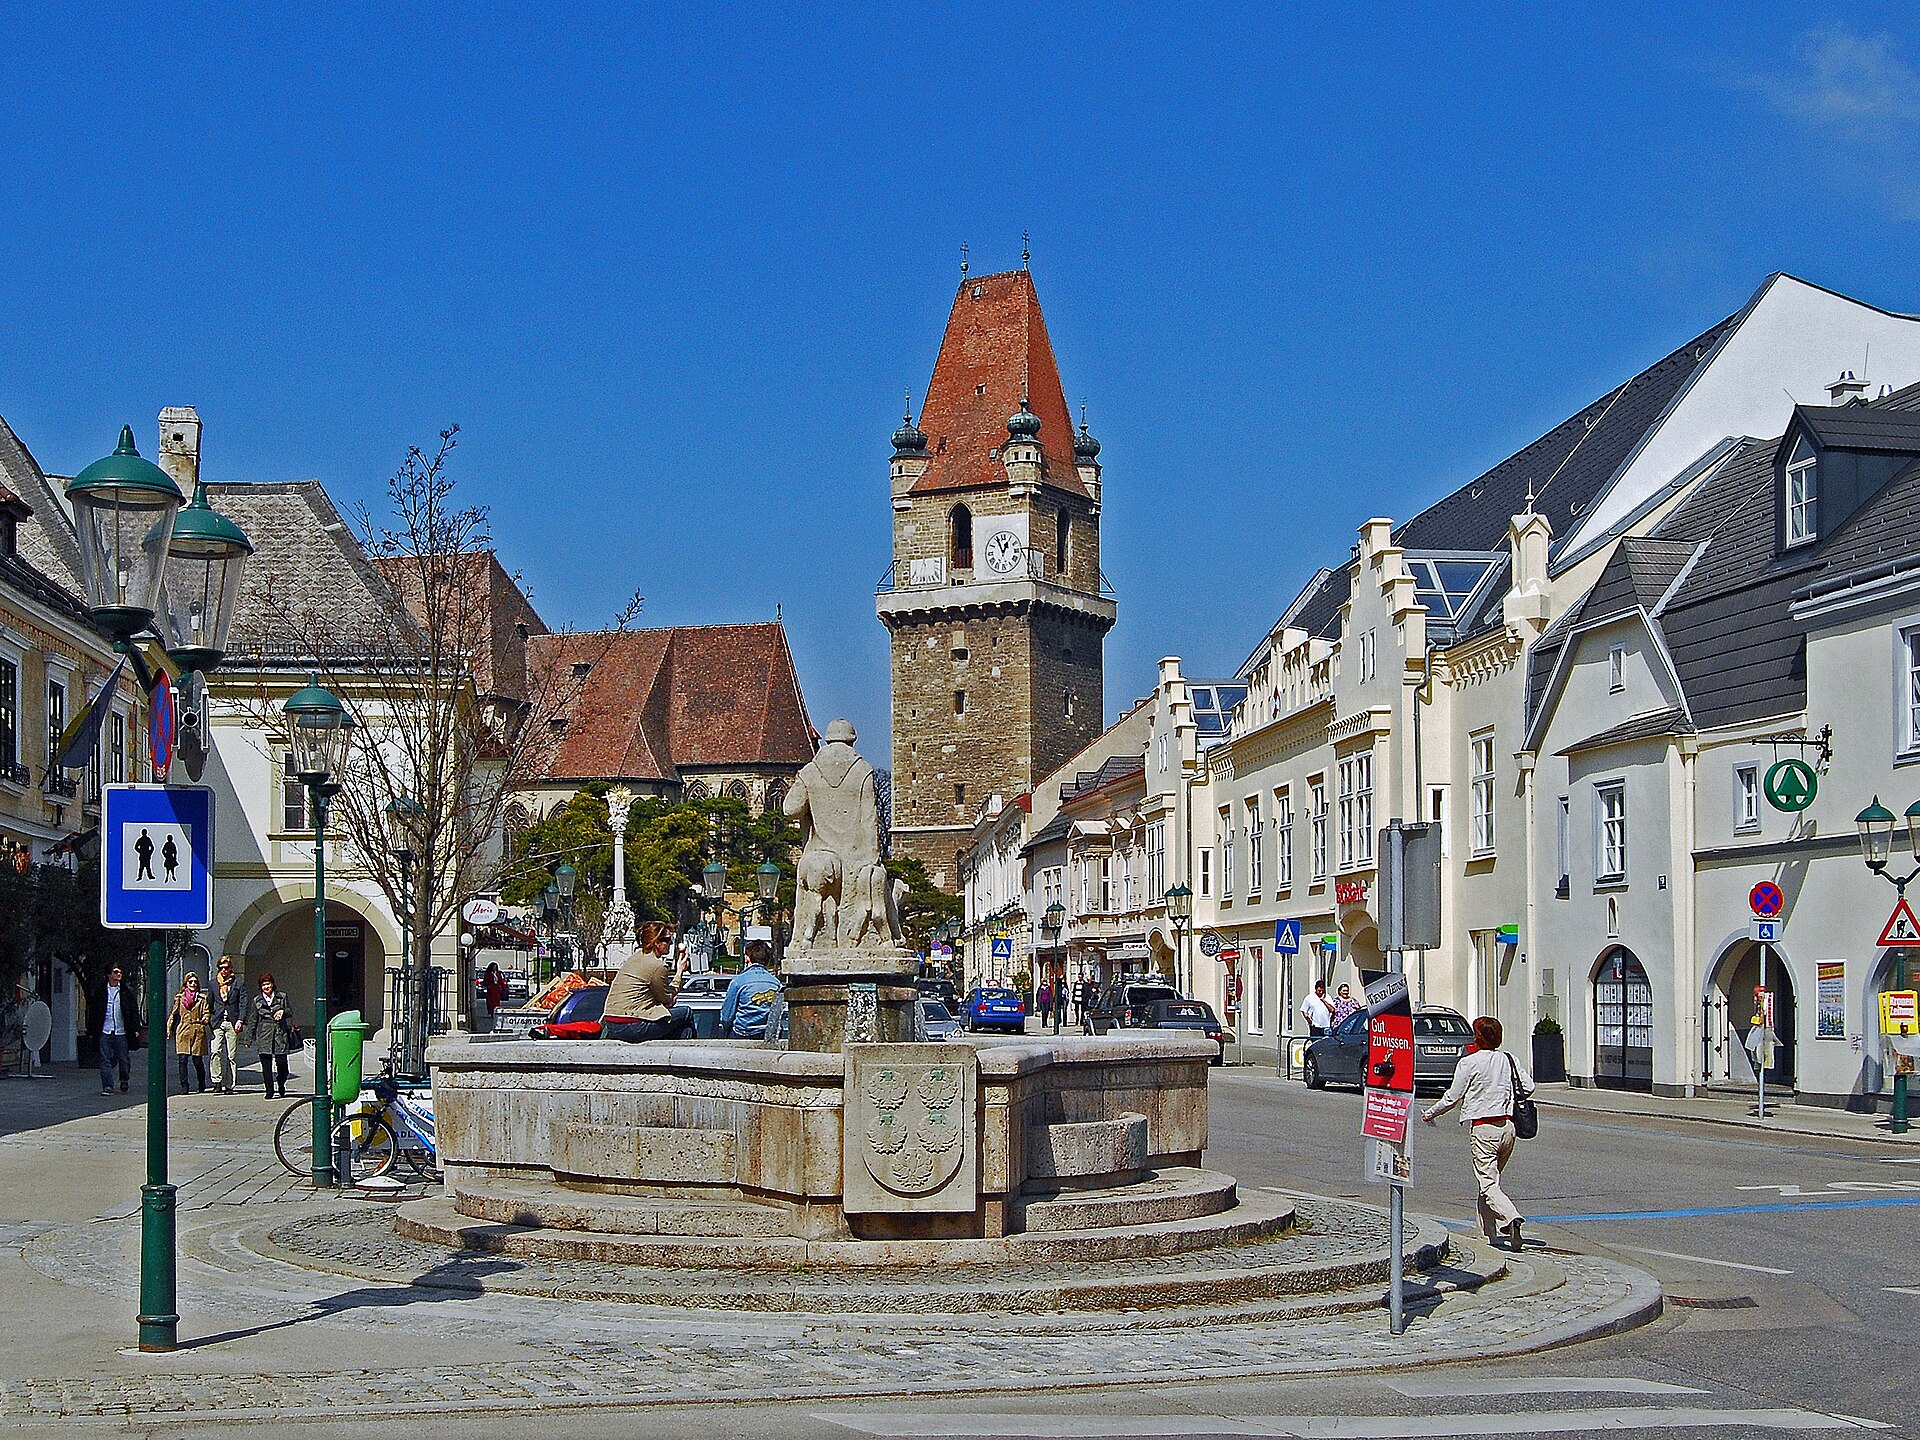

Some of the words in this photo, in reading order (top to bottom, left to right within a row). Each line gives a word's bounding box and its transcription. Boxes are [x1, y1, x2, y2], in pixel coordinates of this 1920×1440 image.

[1387, 976, 1407, 996] ZEITUN
[1371, 1017, 1386, 1034] Gut
[1372, 1035, 1382, 1047] zu
[1382, 1034, 1411, 1050] wissen.
